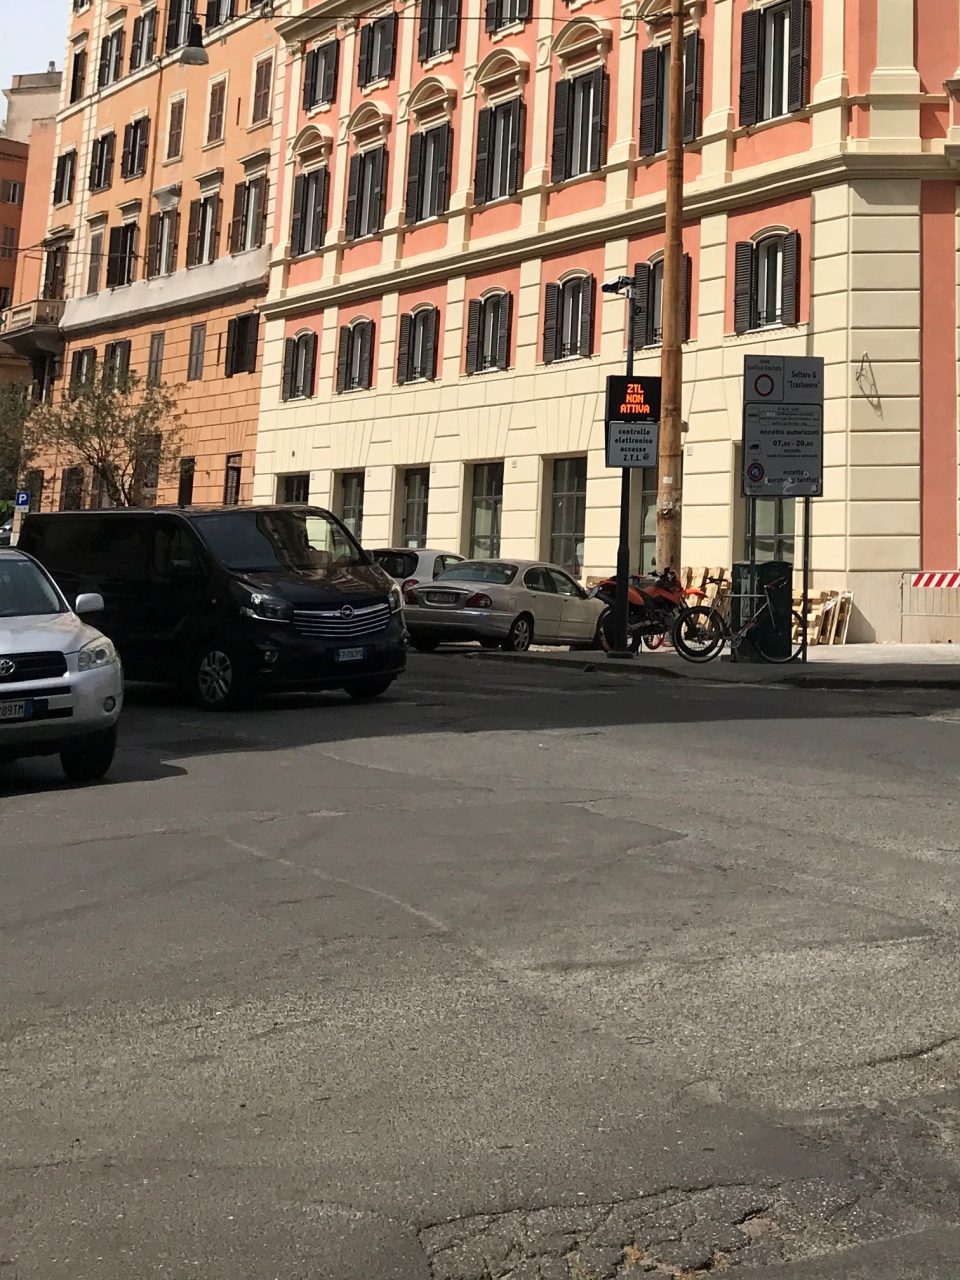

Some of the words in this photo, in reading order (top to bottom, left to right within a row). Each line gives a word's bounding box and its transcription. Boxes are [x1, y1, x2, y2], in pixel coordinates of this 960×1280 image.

[627, 384, 644, 393] ZTL
[626, 394, 644, 403] NON
[620, 404, 650, 414] ATTIVA
[19, 494, 27, 504] P
